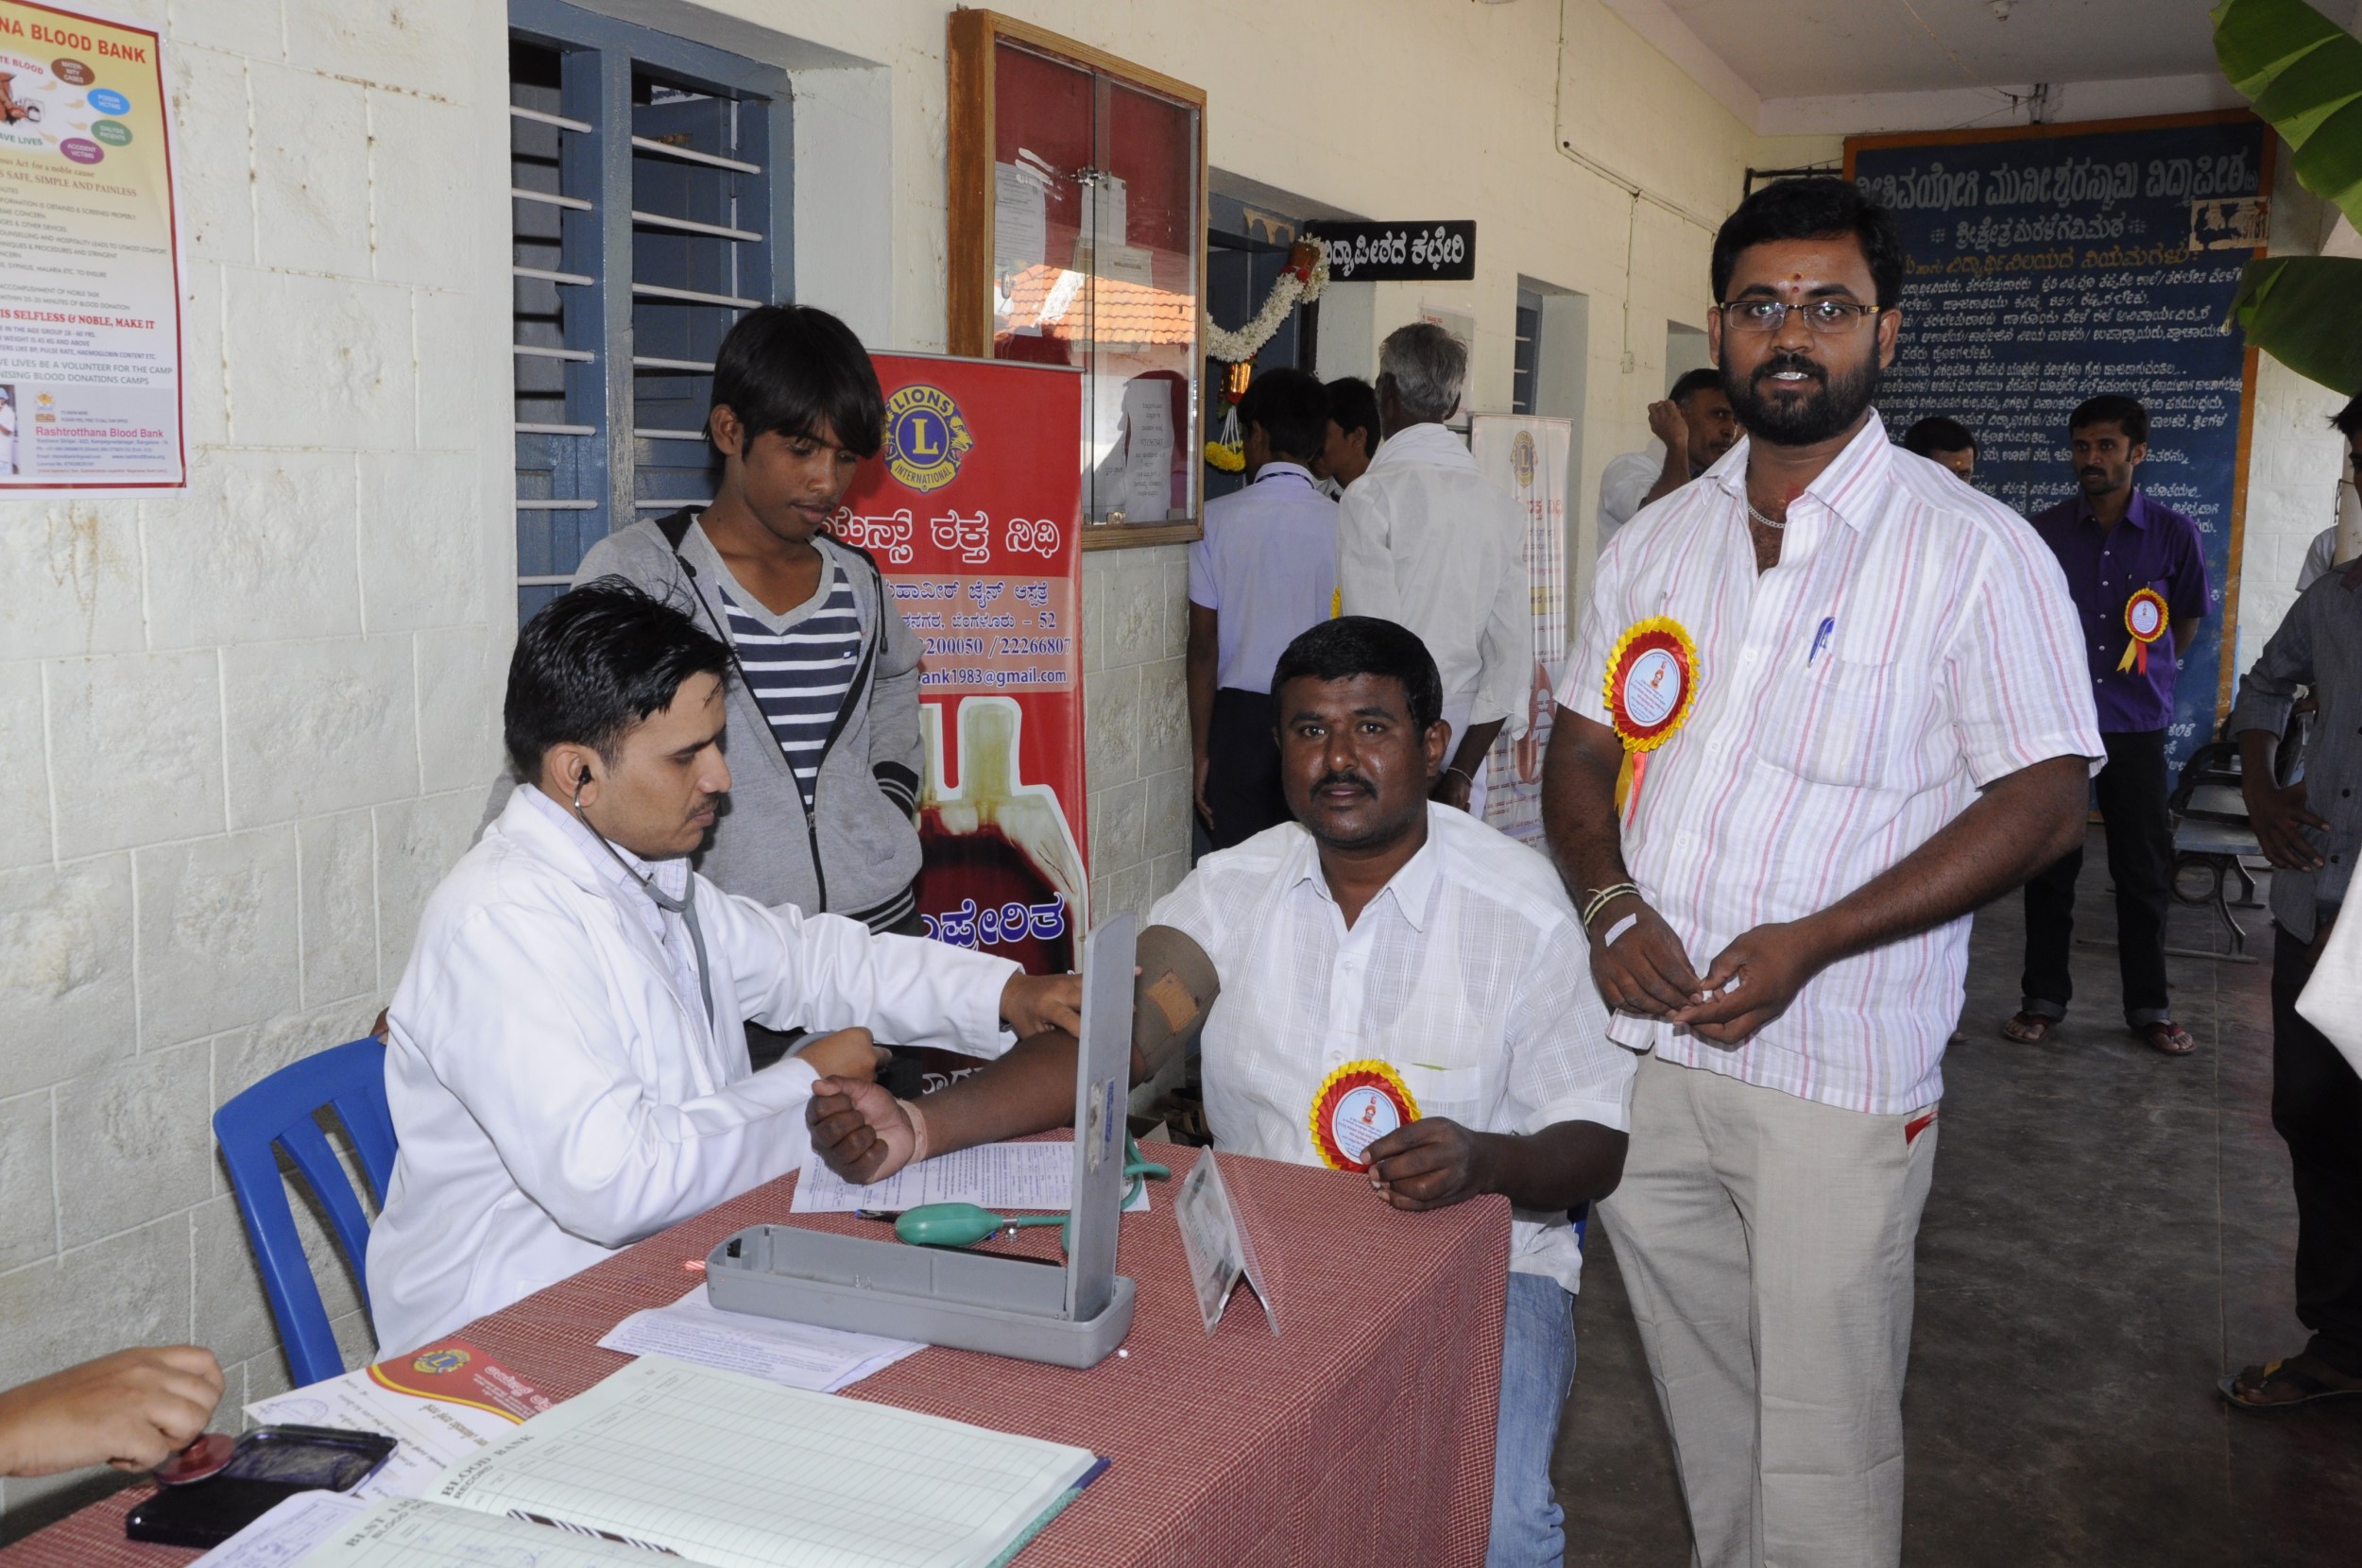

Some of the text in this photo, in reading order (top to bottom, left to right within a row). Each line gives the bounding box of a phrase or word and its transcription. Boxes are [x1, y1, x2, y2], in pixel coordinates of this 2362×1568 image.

[31, 24, 92, 51] BLOOD
[98, 40, 145, 64] BANK
[12, 59, 43, 75] BLOOD
[18, 137, 43, 145] LIVES
[32, 160, 43, 170] for
[51, 165, 73, 175] noble
[7, 170, 137, 197] SAFE, SIMPLE AND PAINLESS
[2049, 295, 2075, 306] 85%
[14, 310, 65, 323] SELFLESS
[68, 314, 77, 323] &
[78, 315, 113, 328] NOBLE,
[115, 317, 144, 329] MAKE
[145, 320, 155, 330] IT
[11, 359, 37, 368] LIVES
[39, 360, 50, 368] BE
[52, 361, 60, 369] A
[61, 362, 111, 372] VOLUNTEER
[113, 365, 129, 373] FOR
[132, 366, 147, 374] THE
[149, 366, 173, 375] CAMP
[34, 371, 65, 382] BLOOD
[67, 373, 118, 384] DONATIONS
[120, 377, 149, 385] CAMPS
[893, 388, 950, 414] LIONS
[35, 426, 163, 438] Rashtrotthana Blood Bank
[912, 418, 939, 455] L
[895, 463, 952, 485] INTERNATIONAL
[930, 509, 991, 564] ರಕ್ತ
[1005, 518, 1061, 559] ನಿಧಿ
[968, 579, 1004, 608] ಜೈನ್
[1038, 611, 1056, 629] 52
[918, 636, 983, 656] 200050
[441, 1435, 535, 1496] BLOOD BANK
[454, 1465, 493, 1500] RECORD
